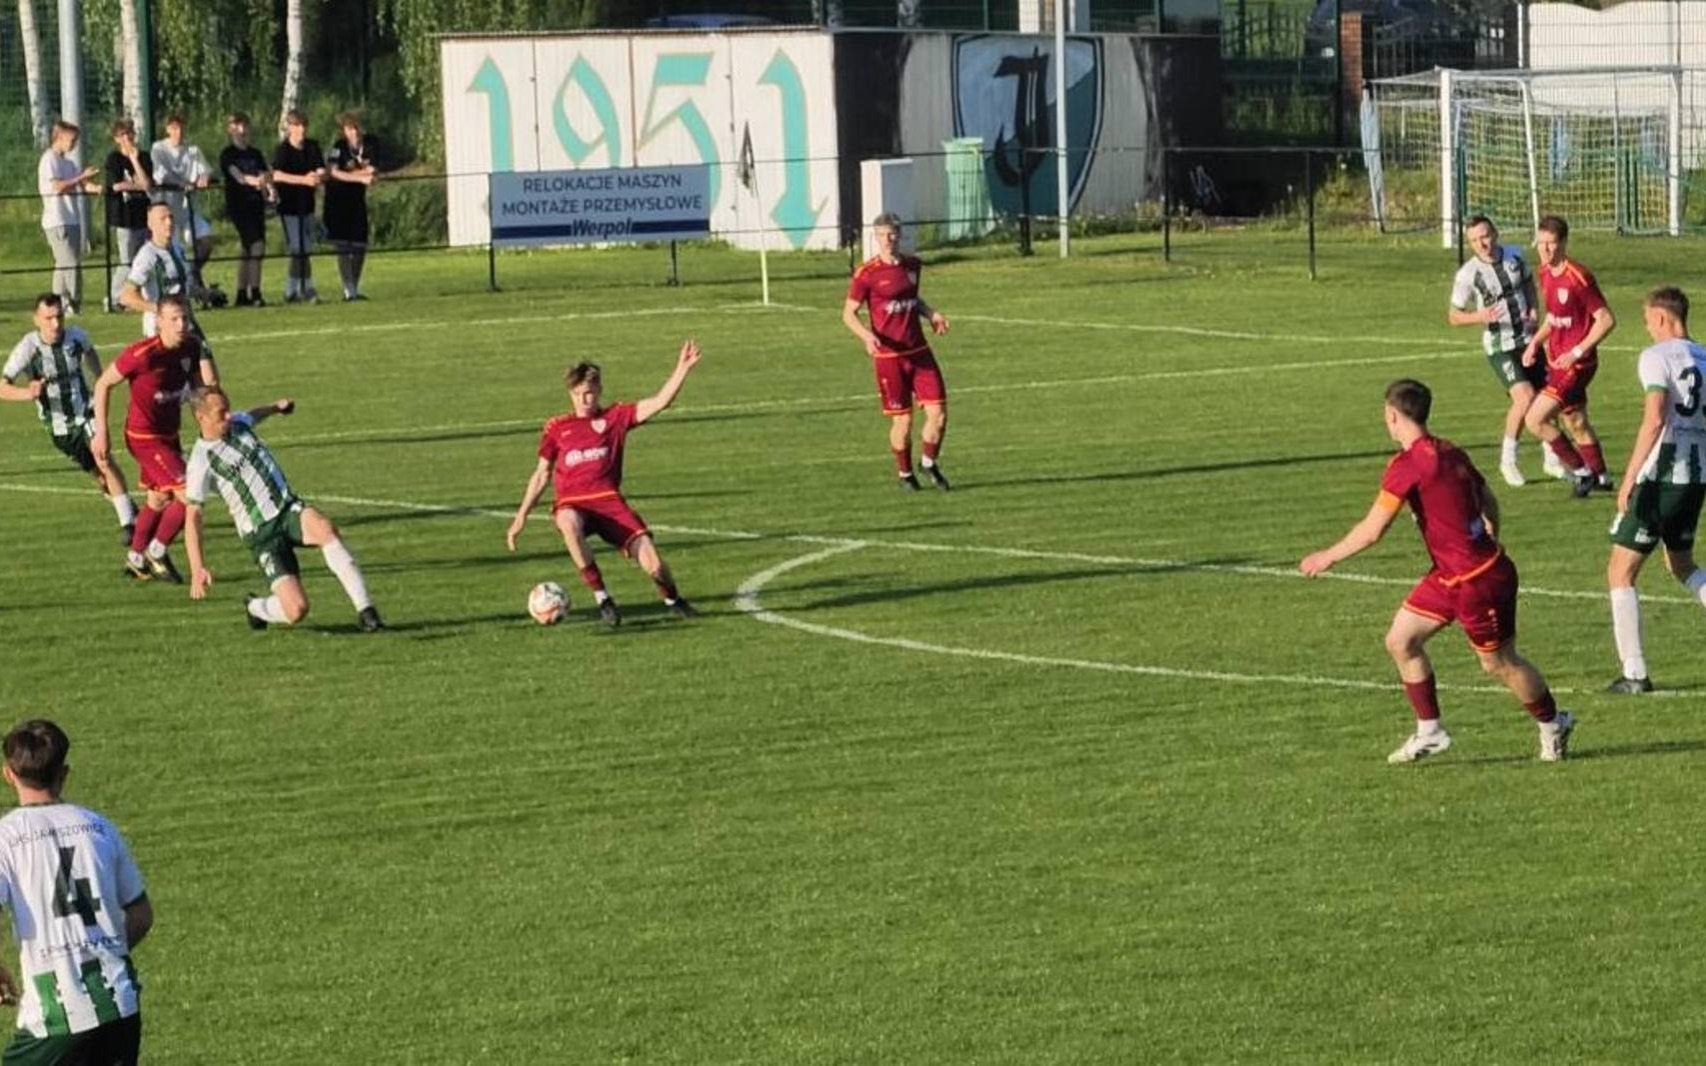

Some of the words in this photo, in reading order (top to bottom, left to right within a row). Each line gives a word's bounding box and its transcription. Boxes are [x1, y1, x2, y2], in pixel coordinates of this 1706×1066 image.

[466, 48, 829, 249] 1951
[523, 176, 613, 194] RELOKACJE
[618, 174, 682, 190] MASZYN
[502, 197, 579, 216] MONTAŻE
[583, 195, 703, 213] PRZEMYSŁOWE
[571, 217, 633, 240] Werpol
[1675, 366, 1706, 417] 3
[52, 846, 101, 926] 4
